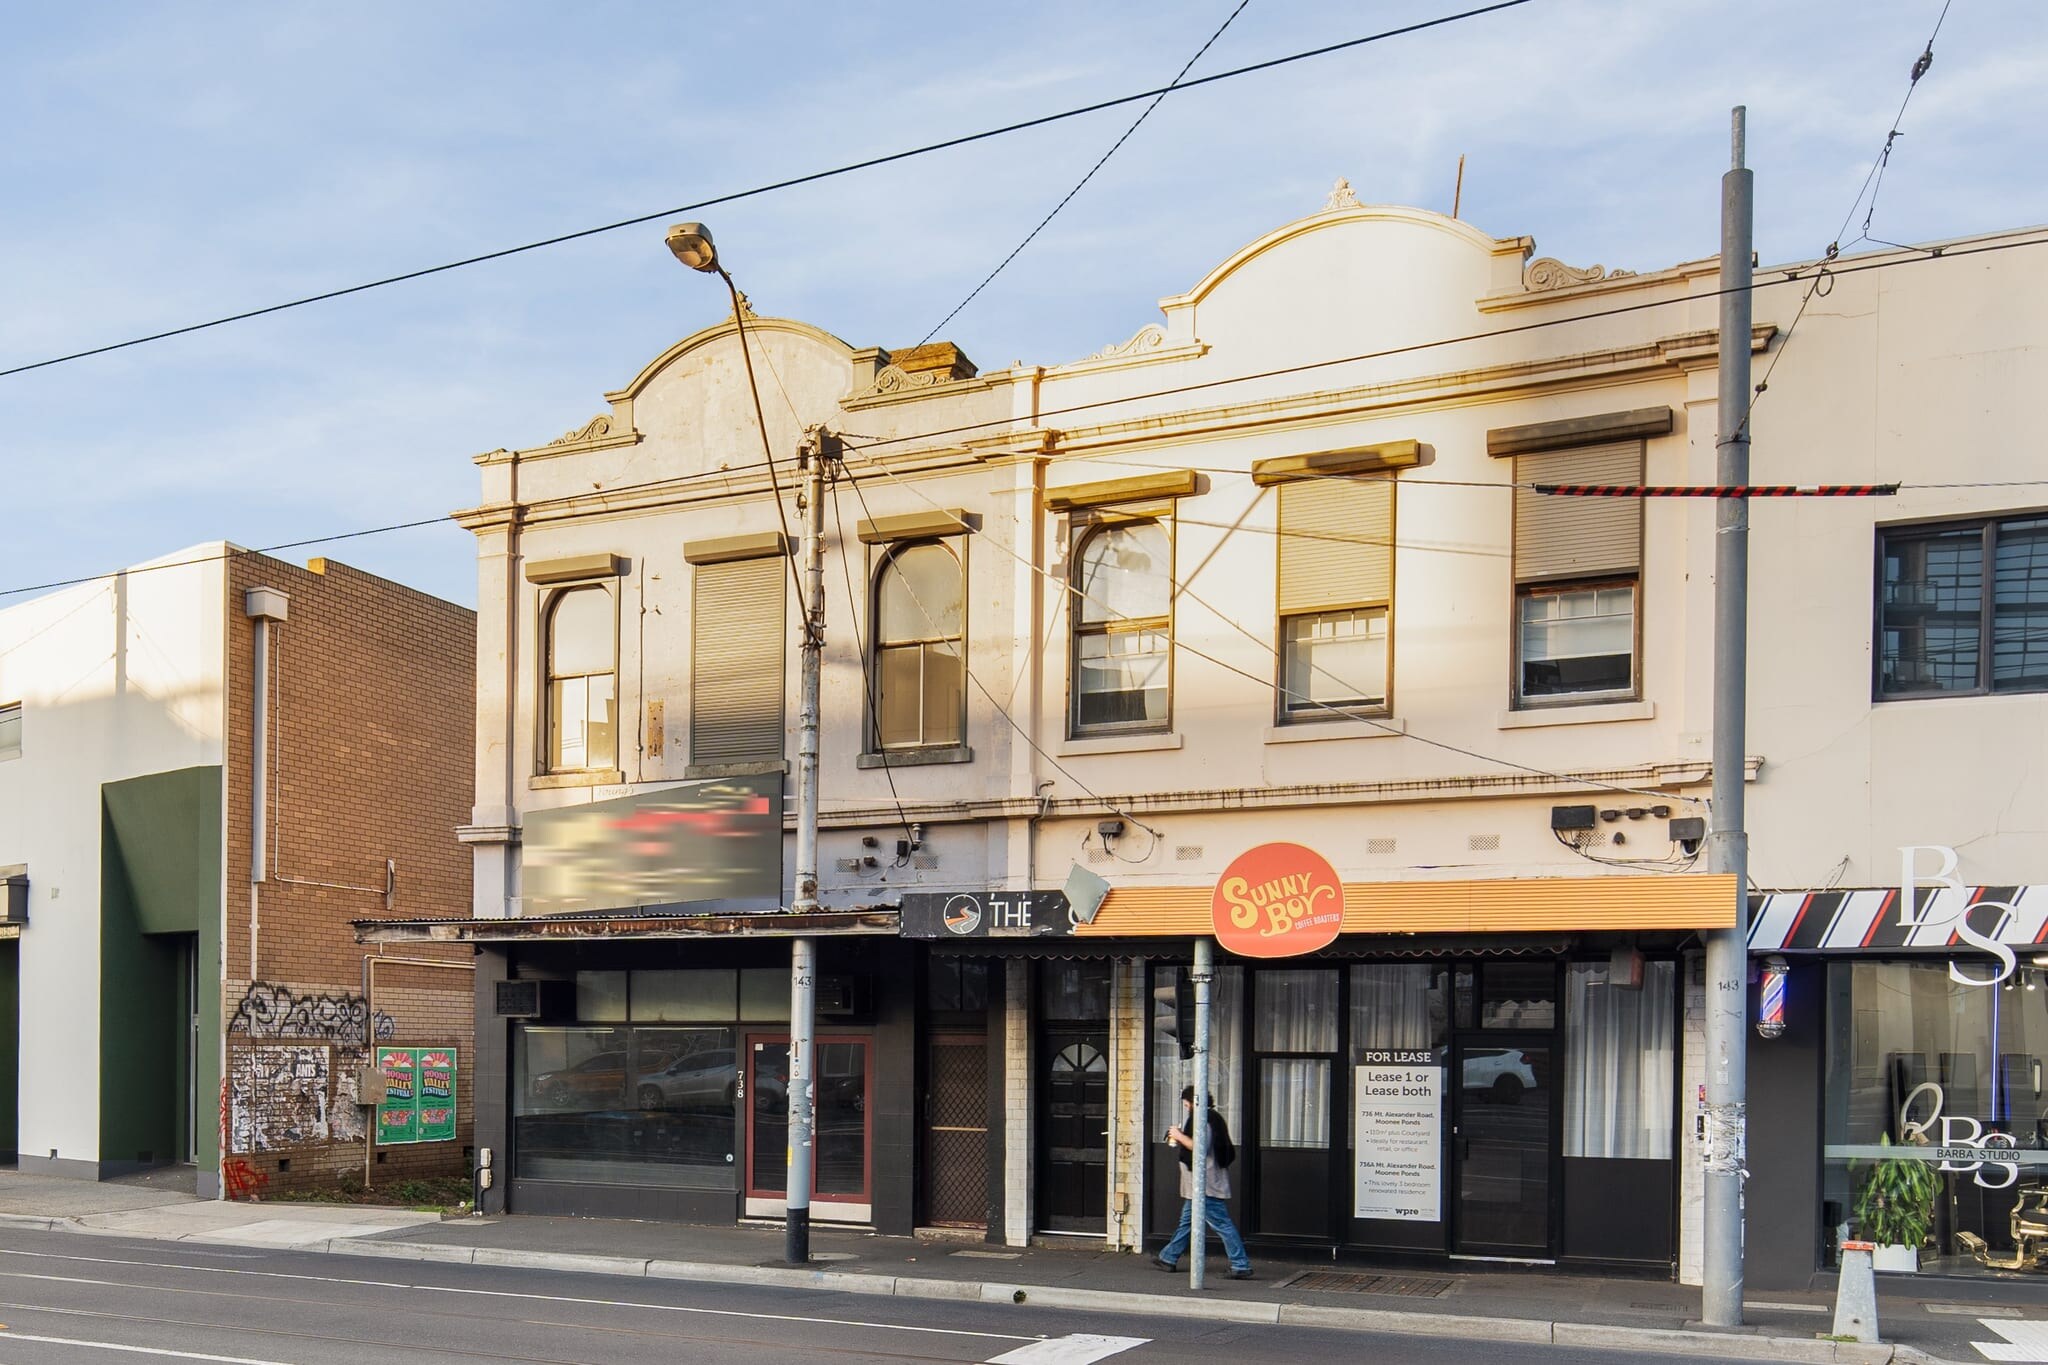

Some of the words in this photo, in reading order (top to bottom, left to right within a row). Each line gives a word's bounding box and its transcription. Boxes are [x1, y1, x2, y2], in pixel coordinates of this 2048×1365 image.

[988, 901, 1031, 927] THE
[1260, 885, 1336, 937] BOY
[1294, 916, 1313, 930] COFFEE
[1313, 913, 1340, 925] ROASTERS
[794, 976, 811, 986] 143
[1718, 979, 1739, 992] 143
[1365, 1051, 1391, 1063] FOR
[1394, 1051, 1432, 1063] LEASE
[1368, 1072, 1402, 1082] Lease
[1405, 1072, 1412, 1082] 1
[1415, 1074, 1429, 1082] or
[424, 1078, 450, 1089] VALLEY
[1365, 1086, 1399, 1096] Lease
[1403, 1086, 1432, 1097] both
[1937, 1148, 1974, 1159] BARBA
[1979, 1149, 2021, 1161] STUDIO
